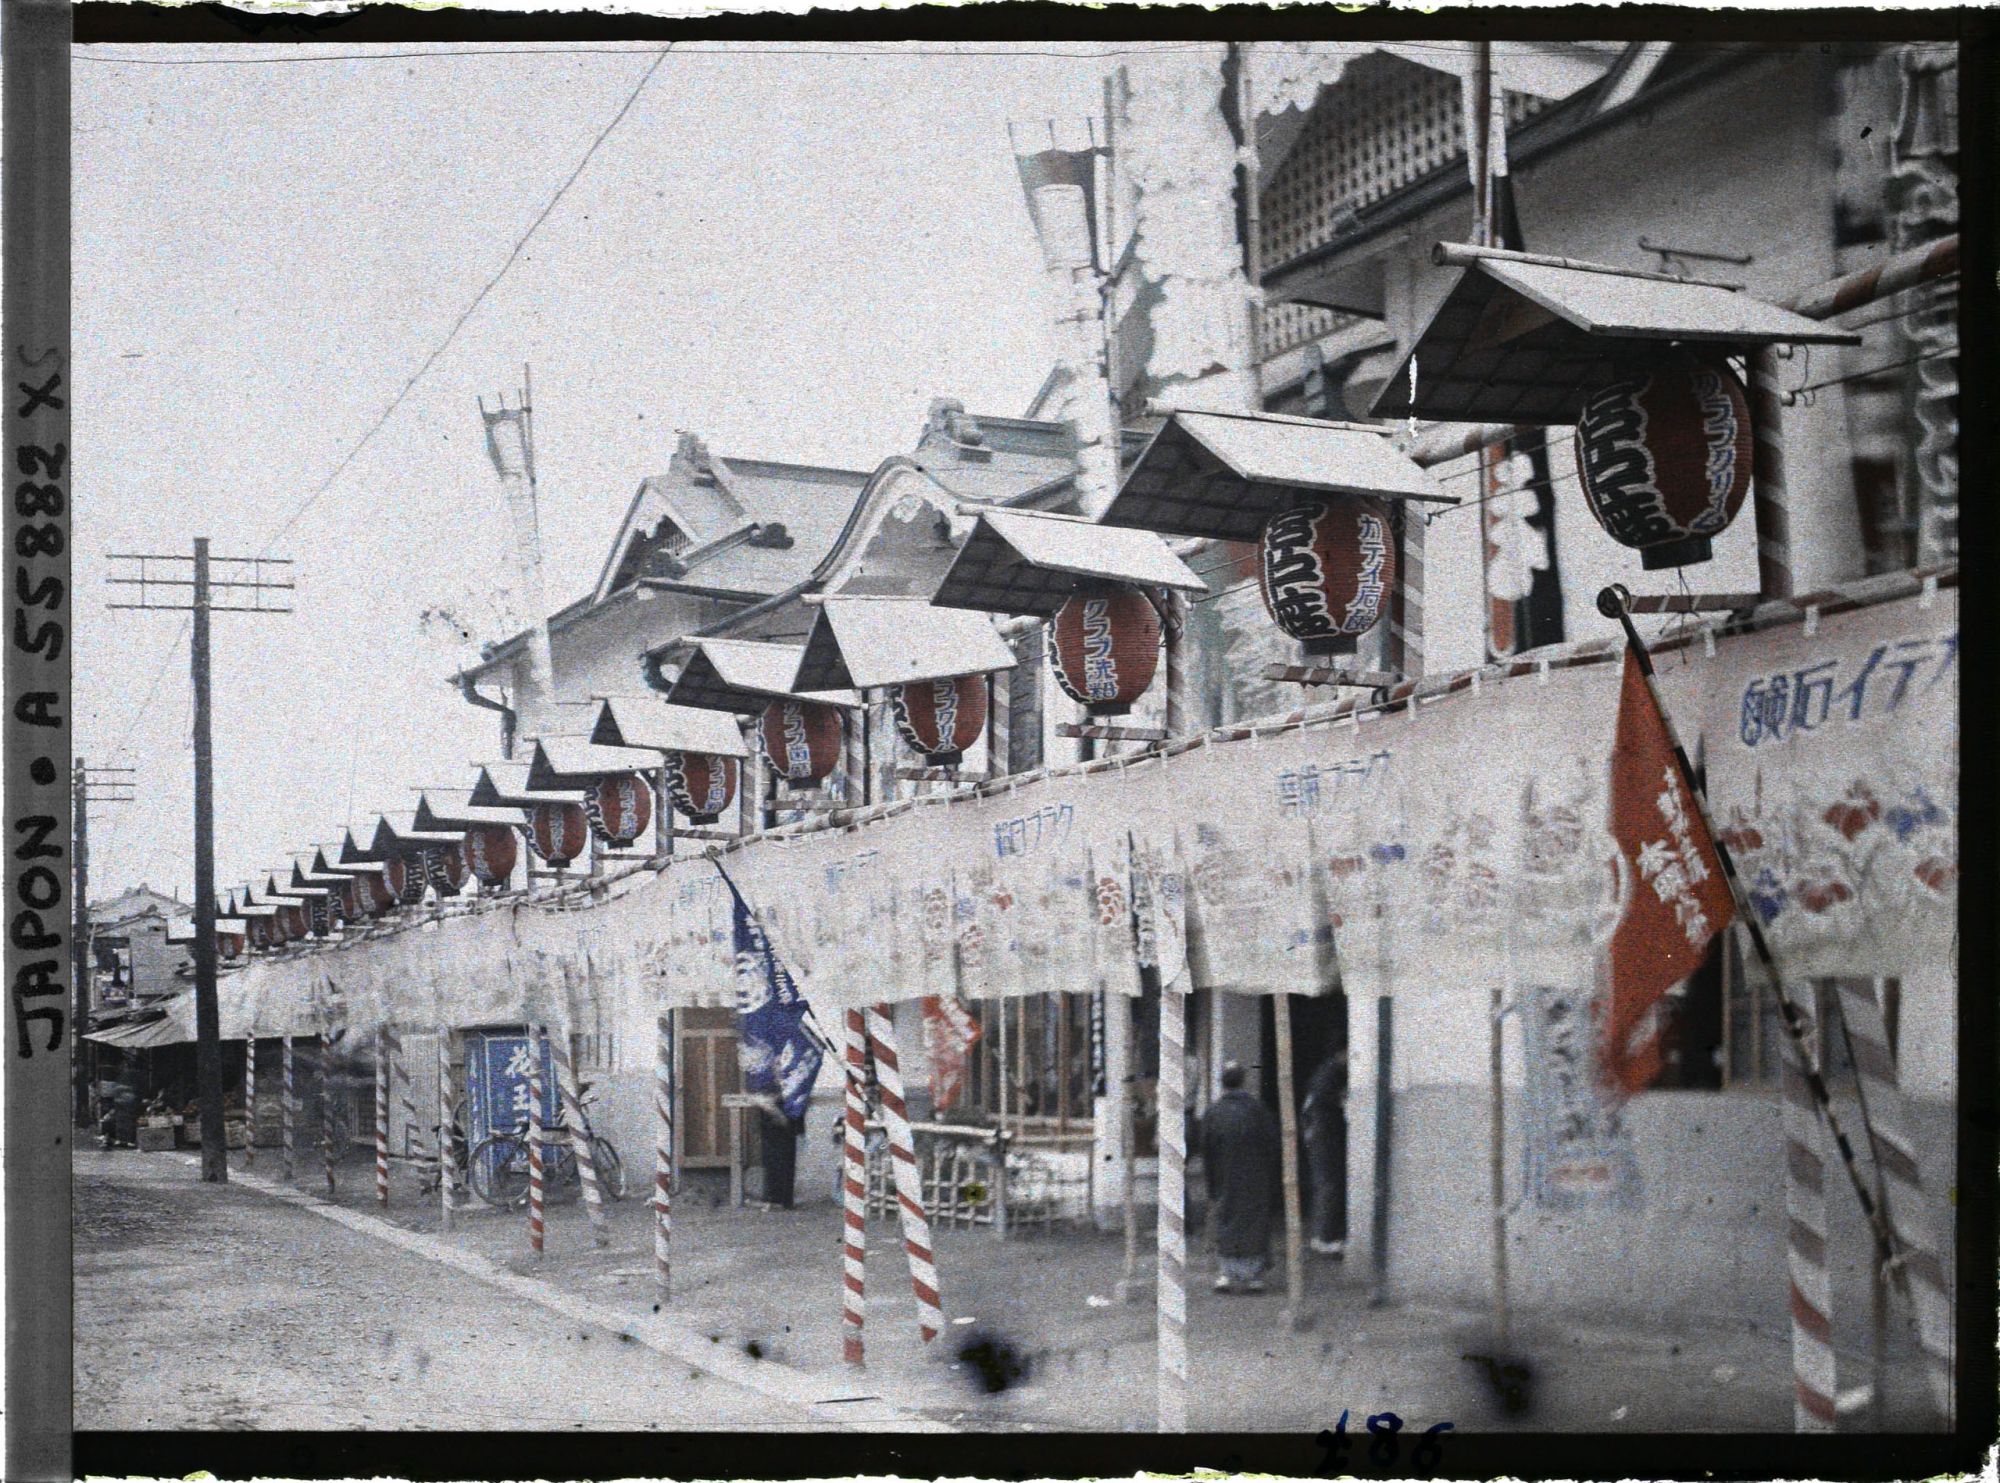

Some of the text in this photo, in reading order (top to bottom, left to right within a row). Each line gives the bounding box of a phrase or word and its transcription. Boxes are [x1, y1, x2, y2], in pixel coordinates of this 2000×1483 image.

[14, 442, 66, 662] 55882
[13, 691, 62, 729] A
[10, 816, 65, 1059] JAPON
